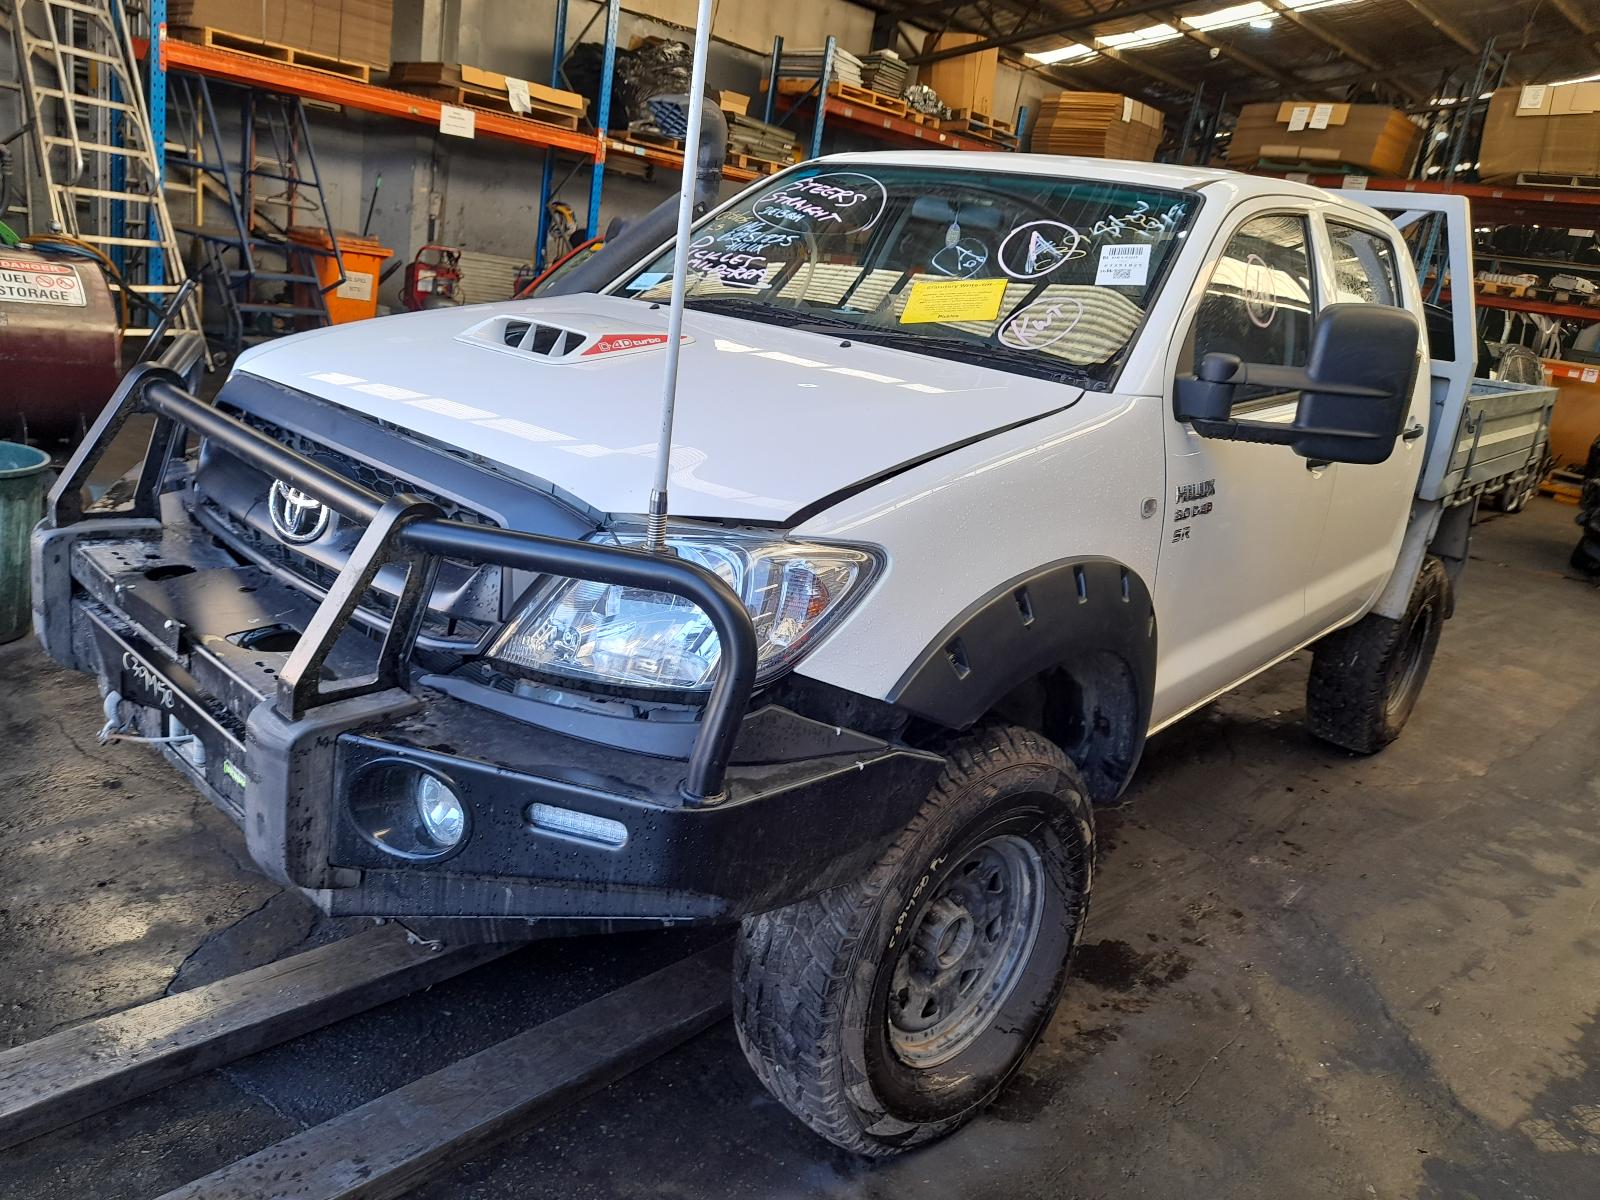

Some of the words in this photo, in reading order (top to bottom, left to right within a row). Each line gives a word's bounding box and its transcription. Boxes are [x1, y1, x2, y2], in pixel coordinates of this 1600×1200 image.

[788, 178, 867, 208] STEERS
[761, 191, 843, 223] STRAIGHT
[0, 261, 58, 273] DANGER
[0, 273, 32, 284] UEL
[0, 285, 70, 300] STORAGE
[632, 337, 661, 346] turbo
